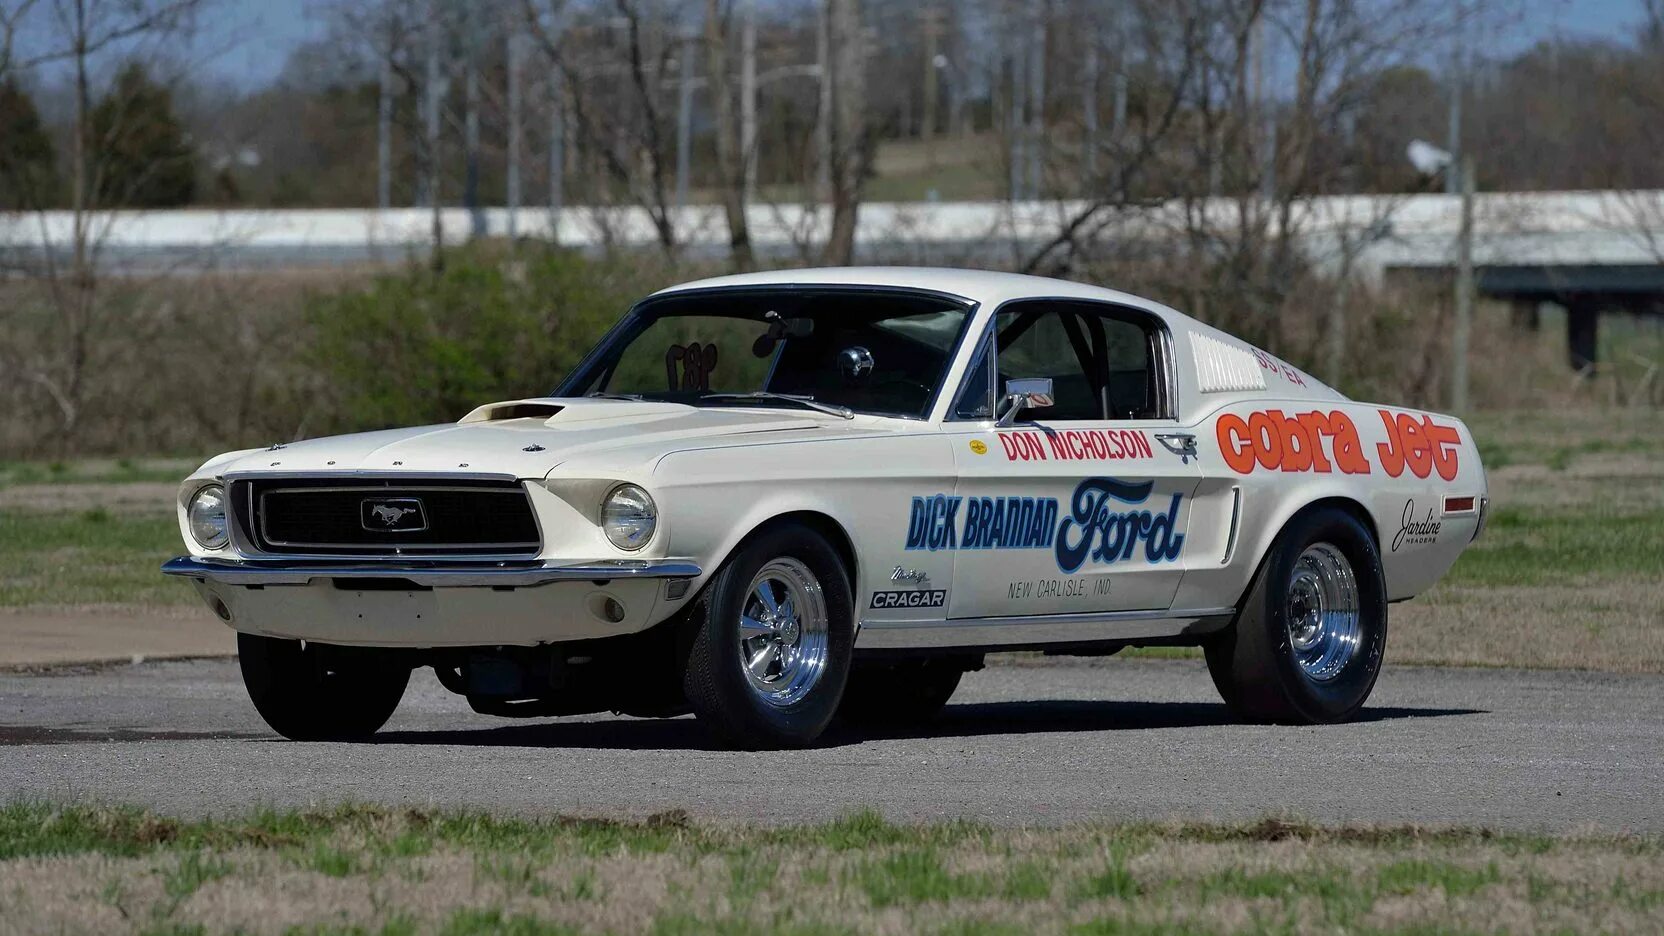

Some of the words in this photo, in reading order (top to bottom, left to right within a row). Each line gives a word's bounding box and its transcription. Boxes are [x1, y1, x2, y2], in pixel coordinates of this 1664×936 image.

[1251, 347, 1307, 388] SS/EA
[998, 432, 1047, 461] DON
[1049, 430, 1154, 460] NICHOLSON
[905, 494, 963, 552] DICK
[1055, 476, 1185, 574] Ford
[1392, 499, 1441, 552] Jardine
[1406, 537, 1437, 545] HEADERS
[872, 591, 944, 608] CRAGAR
[1008, 581, 1033, 599] NEW
[1037, 580, 1088, 599] CARLISLE,
